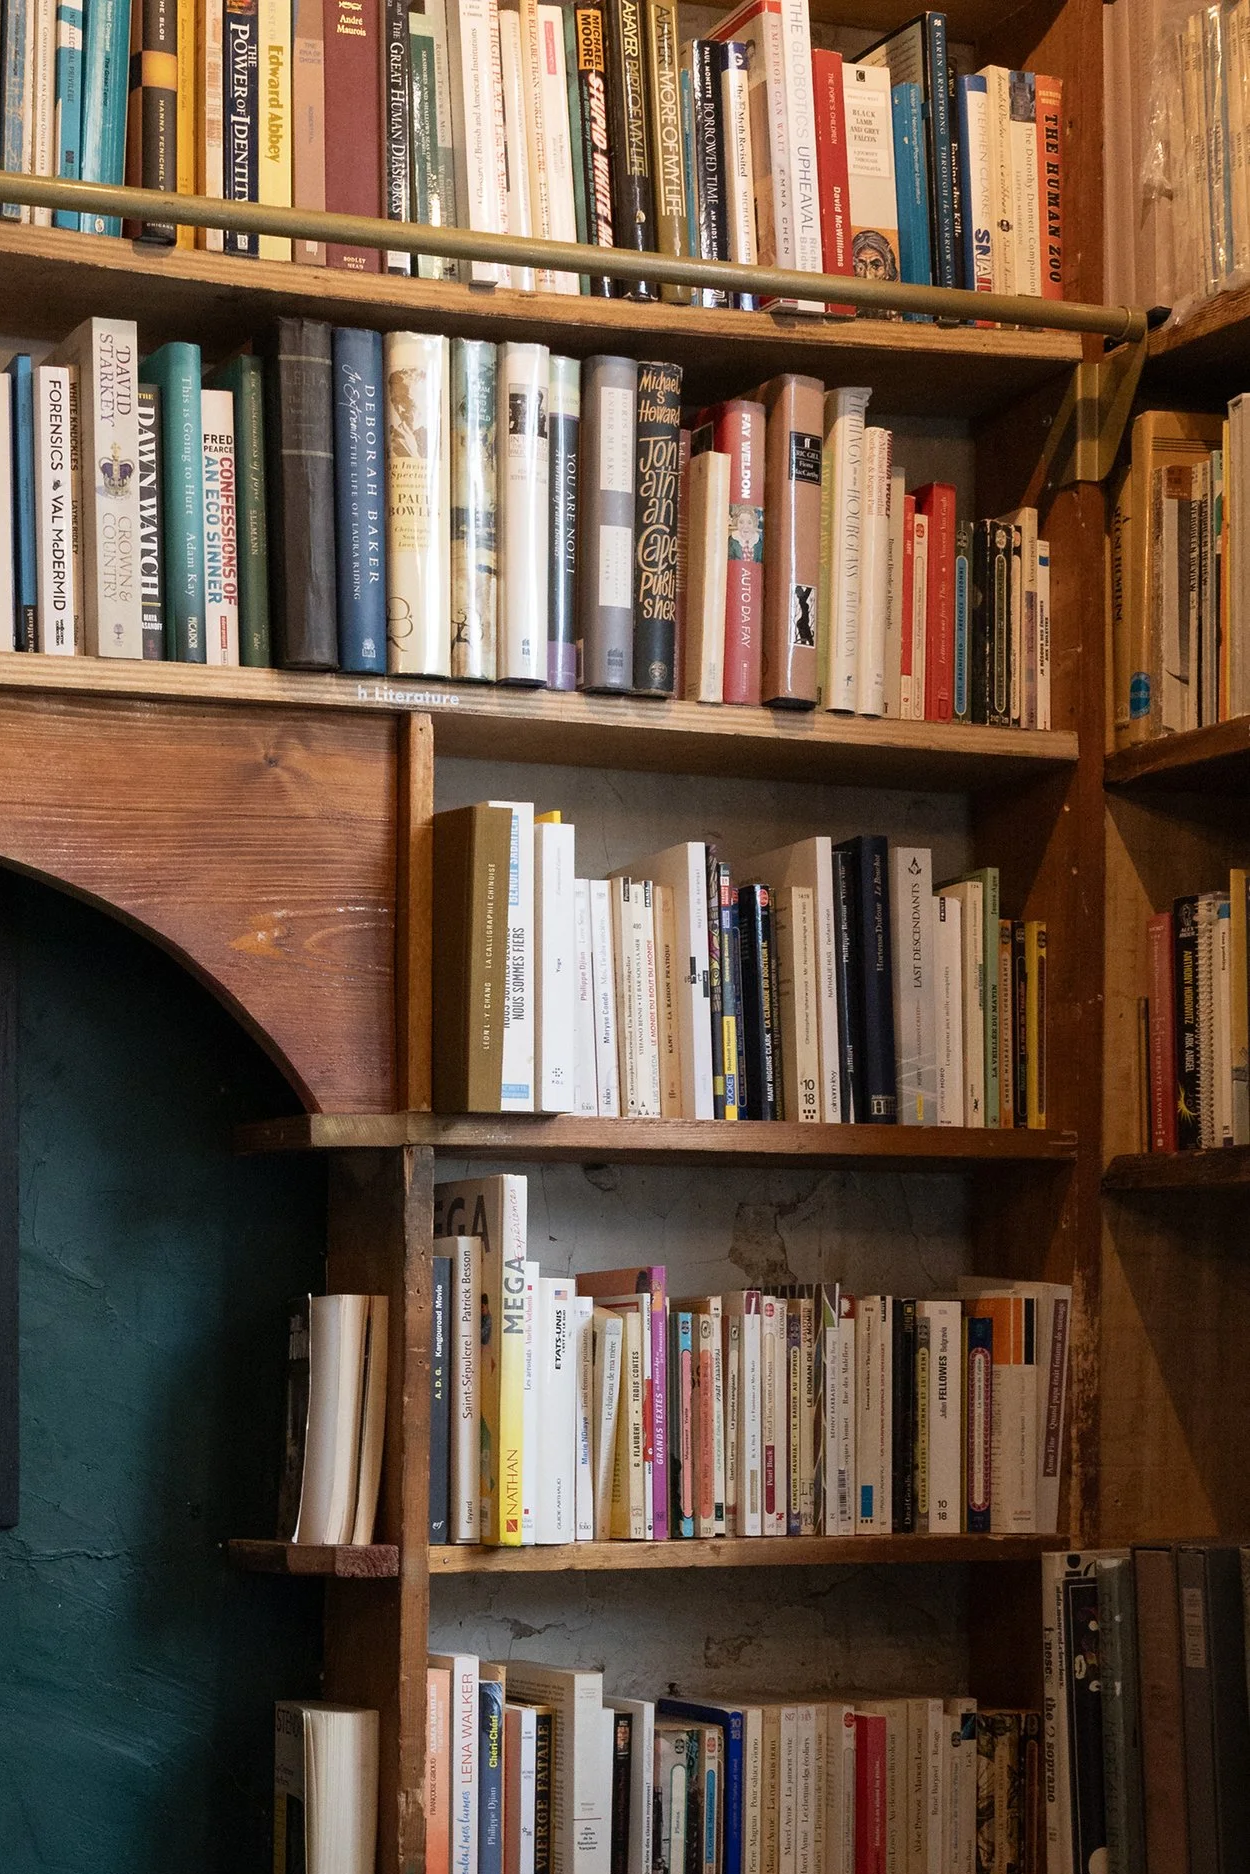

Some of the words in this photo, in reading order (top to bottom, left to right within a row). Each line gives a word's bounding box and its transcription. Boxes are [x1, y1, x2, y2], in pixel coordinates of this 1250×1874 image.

[336, 24, 367, 37] Maurois
[339, 14, 363, 25] André
[392, 20, 402, 39] THE
[581, 13, 594, 68] MOORE
[230, 22, 251, 97] POWER
[248, 44, 257, 68] THE
[389, 42, 404, 84] GREAT
[592, 15, 602, 69] MICHAEL
[267, 45, 285, 110] Edward
[389, 86, 405, 142] HUMAN
[588, 72, 607, 150] STUPID
[266, 113, 282, 164] Abbey
[702, 102, 718, 173] BORROWED
[1045, 114, 1059, 155] THE
[389, 144, 404, 214] DIASPORAS
[593, 151, 612, 224] WHITE
[706, 174, 719, 205] TIME
[833, 186, 842, 212] David
[1047, 161, 1061, 238] HUMAN
[834, 215, 845, 268] McWilliams
[1049, 244, 1063, 284] ZOO
[100, 333, 115, 427] STARKEY
[116, 344, 131, 417] DAVID
[182, 376, 192, 403] This
[638, 370, 680, 395] Michael
[49, 379, 64, 471] FORENSICS
[183, 407, 191, 417] is
[638, 404, 680, 427] Howard
[741, 413, 750, 440] FAY
[139, 405, 156, 494] DAWN
[183, 421, 194, 465] Going
[203, 433, 233, 445] FRED
[203, 445, 233, 454] PEARCE
[364, 384, 377, 497] DEBORAH
[185, 471, 191, 480] to
[204, 456, 219, 486] AN
[740, 442, 751, 499] WELDON
[52, 495, 63, 524] VAL
[185, 484, 195, 516] Hurt
[205, 489, 220, 526] ECO
[220, 457, 237, 572] CONFESSIONS
[103, 512, 117, 602] COUNTRY
[117, 516, 133, 586] CROWN
[140, 495, 159, 596] WATCH
[186, 532, 196, 569] Adam
[367, 511, 379, 584] BAKER
[51, 528, 66, 612] McDERMID
[187, 573, 196, 597] Kay
[207, 532, 222, 605] SINNER
[741, 568, 751, 607] AUTO
[118, 588, 129, 602] &
[222, 575, 237, 606] OF
[741, 609, 751, 627] DA
[741, 628, 751, 648] FAY
[516, 927, 525, 952] FIERS
[912, 883, 921, 959] DESCENDANTS
[514, 954, 525, 996] SOMMES
[913, 962, 922, 988] LAST
[513, 997, 525, 1020] NOUS
[462, 1250, 472, 1280] Besson
[462, 1281, 472, 1322] Patrick
[503, 1255, 526, 1334] MEGA
[462, 1343, 473, 1419] Saint-Sépulcre
[939, 1355, 948, 1400] FELLOWES
[656, 1393, 664, 1427] TEXTES
[656, 1429, 665, 1465] GRANDS
[506, 1449, 518, 1515] NATHAN
[462, 1673, 474, 1738] WALKER
[489, 1714, 498, 1769] Chéri-Chéri
[462, 1742, 473, 1784] LENA
[536, 1724, 550, 1802] FATALE
[536, 1806, 550, 1874] VIERGE
